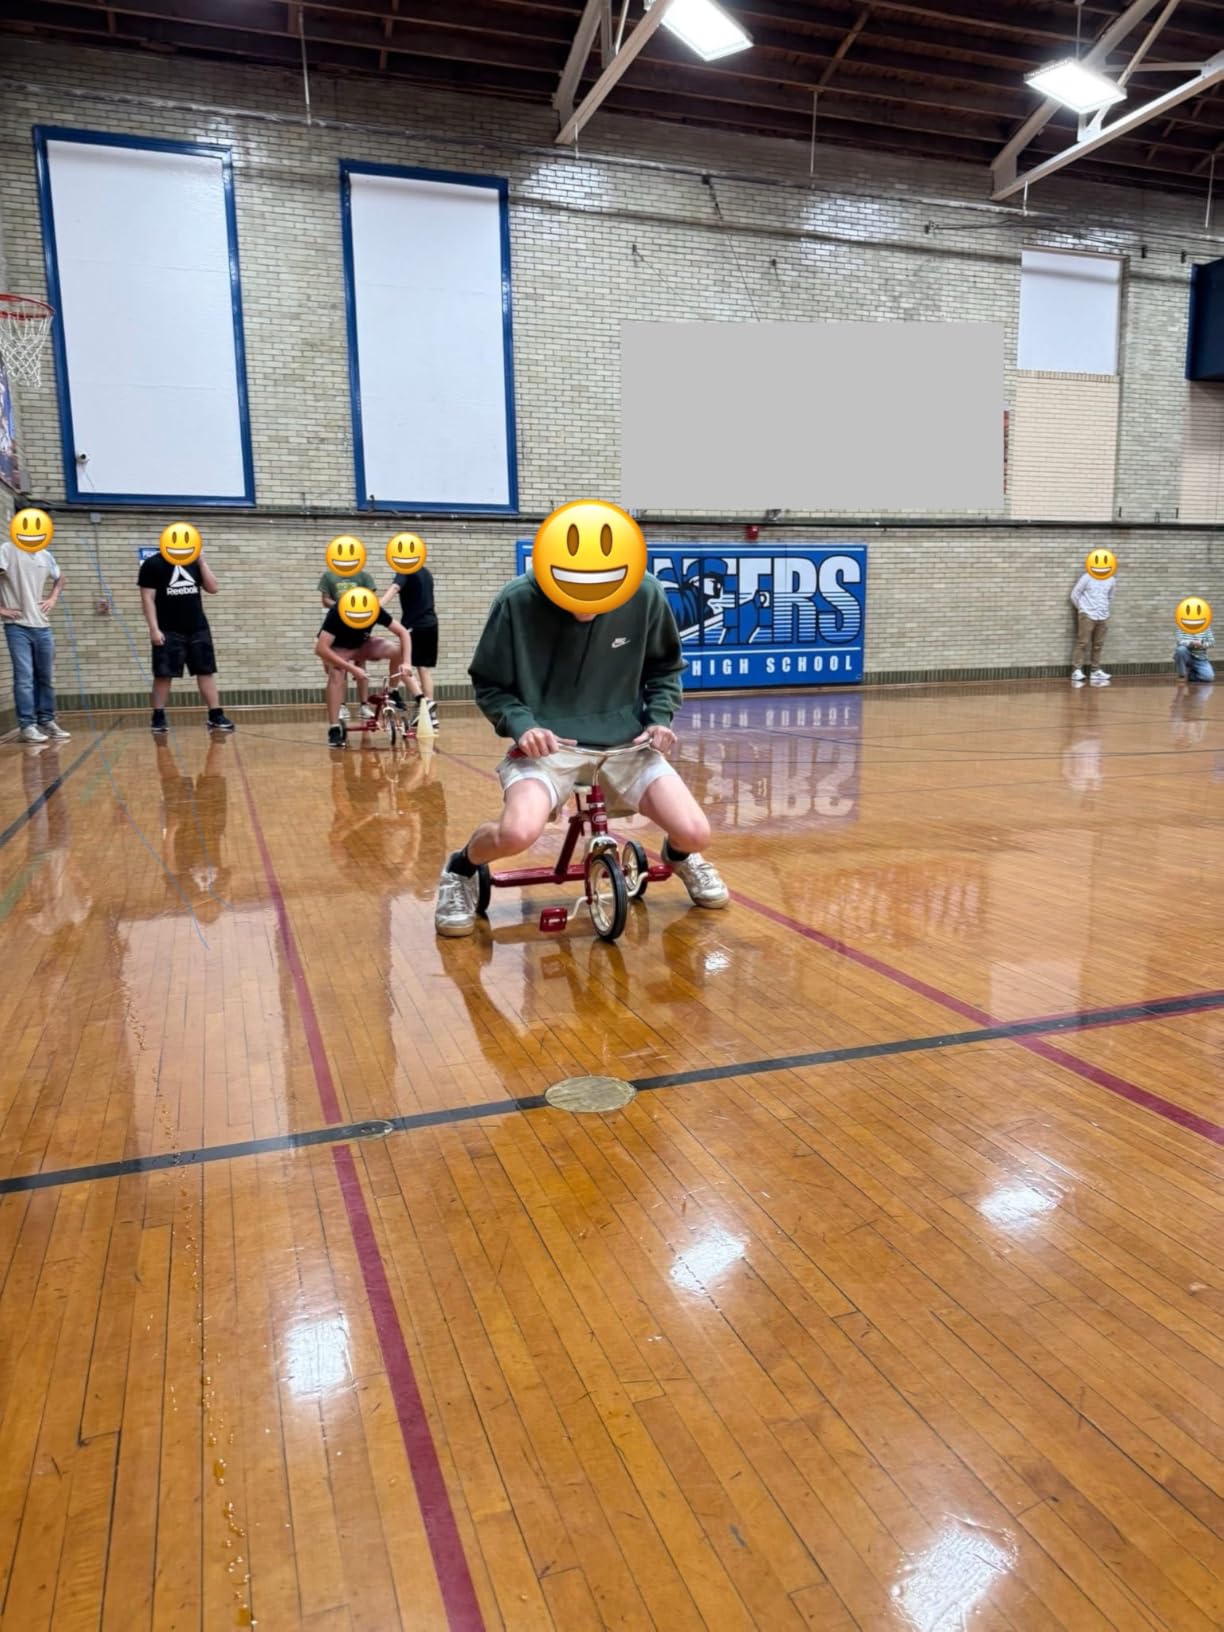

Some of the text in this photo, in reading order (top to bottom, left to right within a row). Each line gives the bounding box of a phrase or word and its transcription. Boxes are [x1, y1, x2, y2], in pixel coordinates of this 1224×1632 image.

[166, 586, 199, 596] Reebok
[692, 655, 852, 676] HIGH SCHOOL
